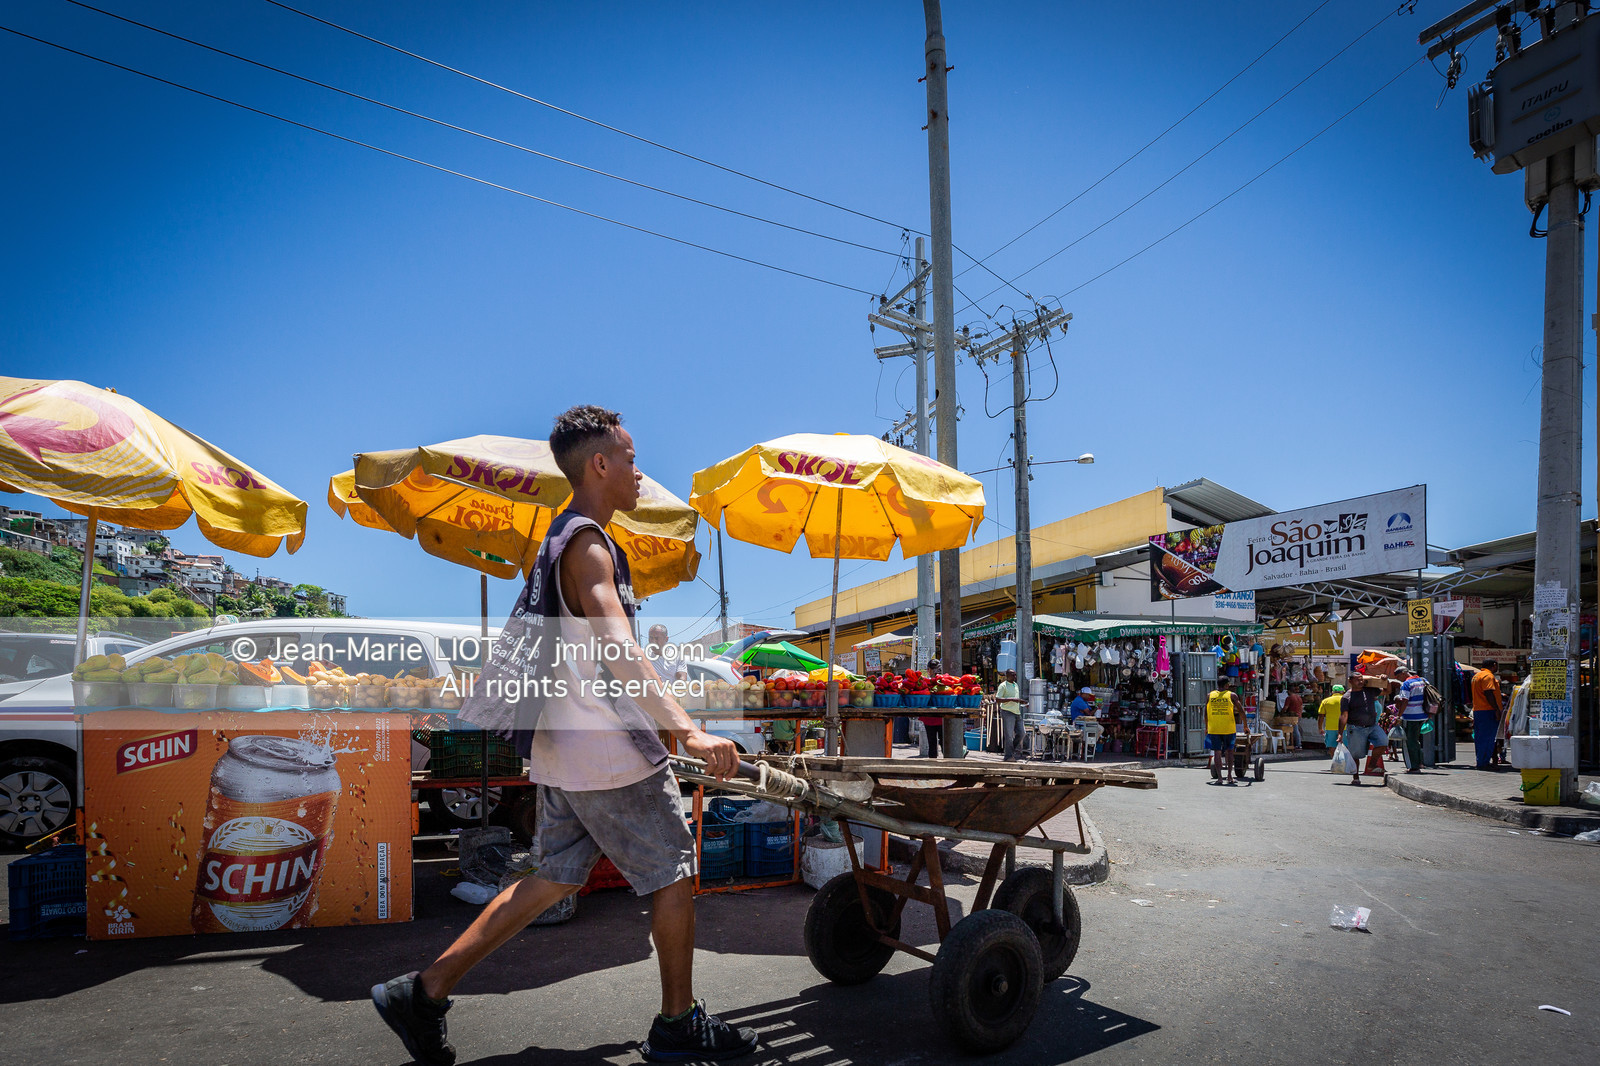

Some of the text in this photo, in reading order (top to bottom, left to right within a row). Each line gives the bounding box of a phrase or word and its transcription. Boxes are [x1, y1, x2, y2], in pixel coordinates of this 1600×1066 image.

[1521, 80, 1569, 111] ITAIPU
[1527, 118, 1573, 143] coelba
[191, 462, 267, 491] SKOL
[446, 454, 544, 496] SKOL
[777, 451, 861, 485] SKOL
[1247, 535, 1266, 544] Feira
[1270, 519, 1322, 546] São
[1384, 541, 1409, 550] BAHIA
[1245, 534, 1365, 576] Joaquim
[1263, 572, 1293, 581] Salvador
[1299, 569, 1319, 577] Bahia
[1325, 564, 1347, 573] Brasil
[1408, 599, 1431, 607] PROIBIDO
[123, 734, 191, 768] SCHIN
[204, 848, 318, 895] SCHIN
